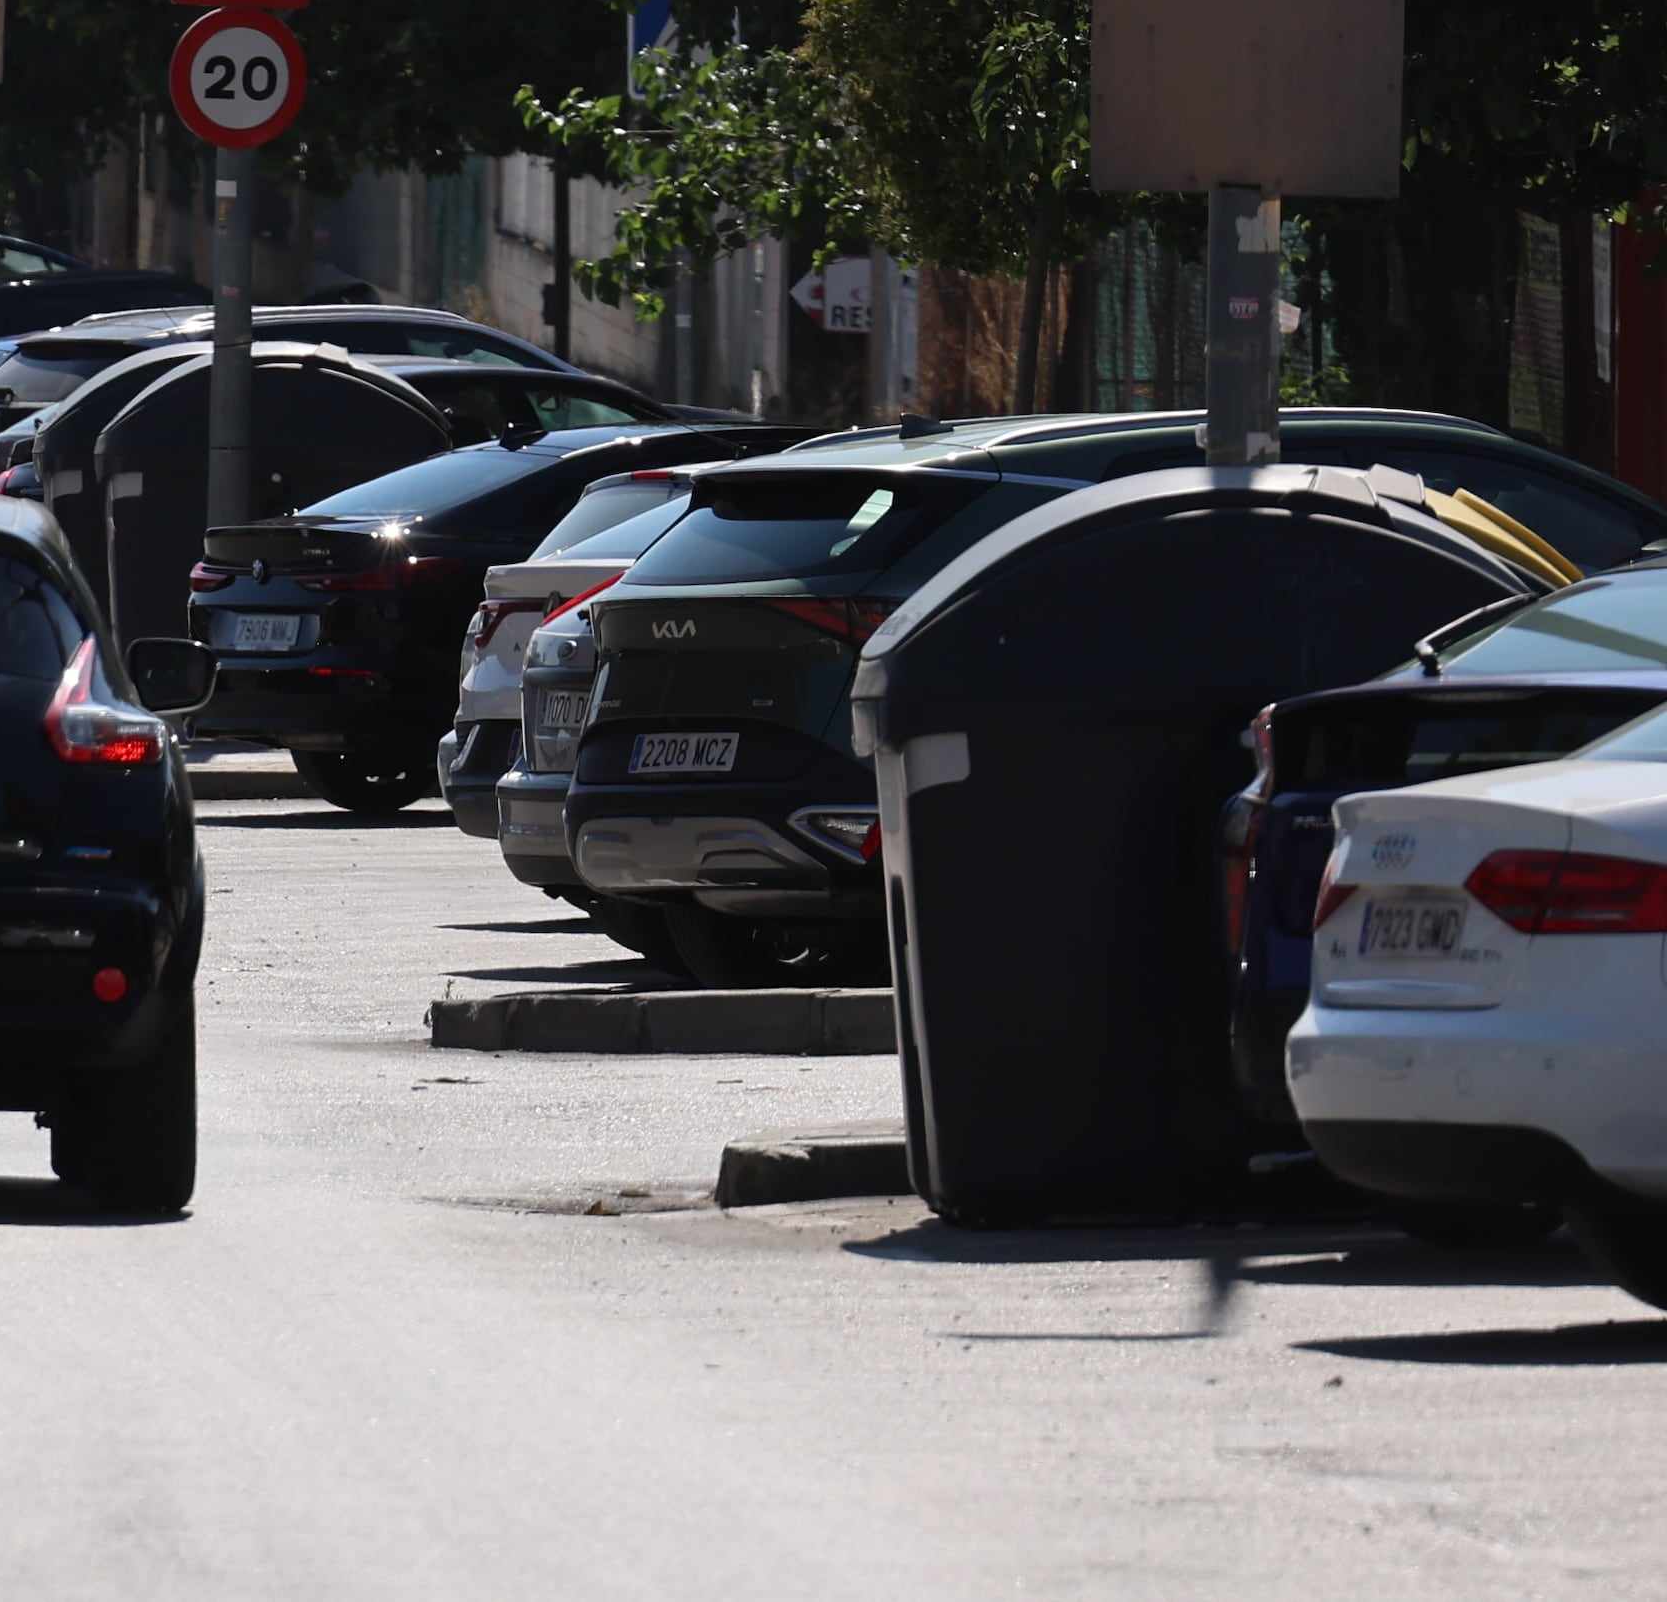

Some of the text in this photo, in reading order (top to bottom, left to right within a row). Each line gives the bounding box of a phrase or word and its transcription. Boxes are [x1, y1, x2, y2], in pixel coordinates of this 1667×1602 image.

[203, 55, 278, 101] 20
[651, 619, 696, 639] KIA
[547, 694, 571, 724] 1070
[641, 737, 732, 768] 2208 MCZ
[1370, 908, 1414, 951] 7923
